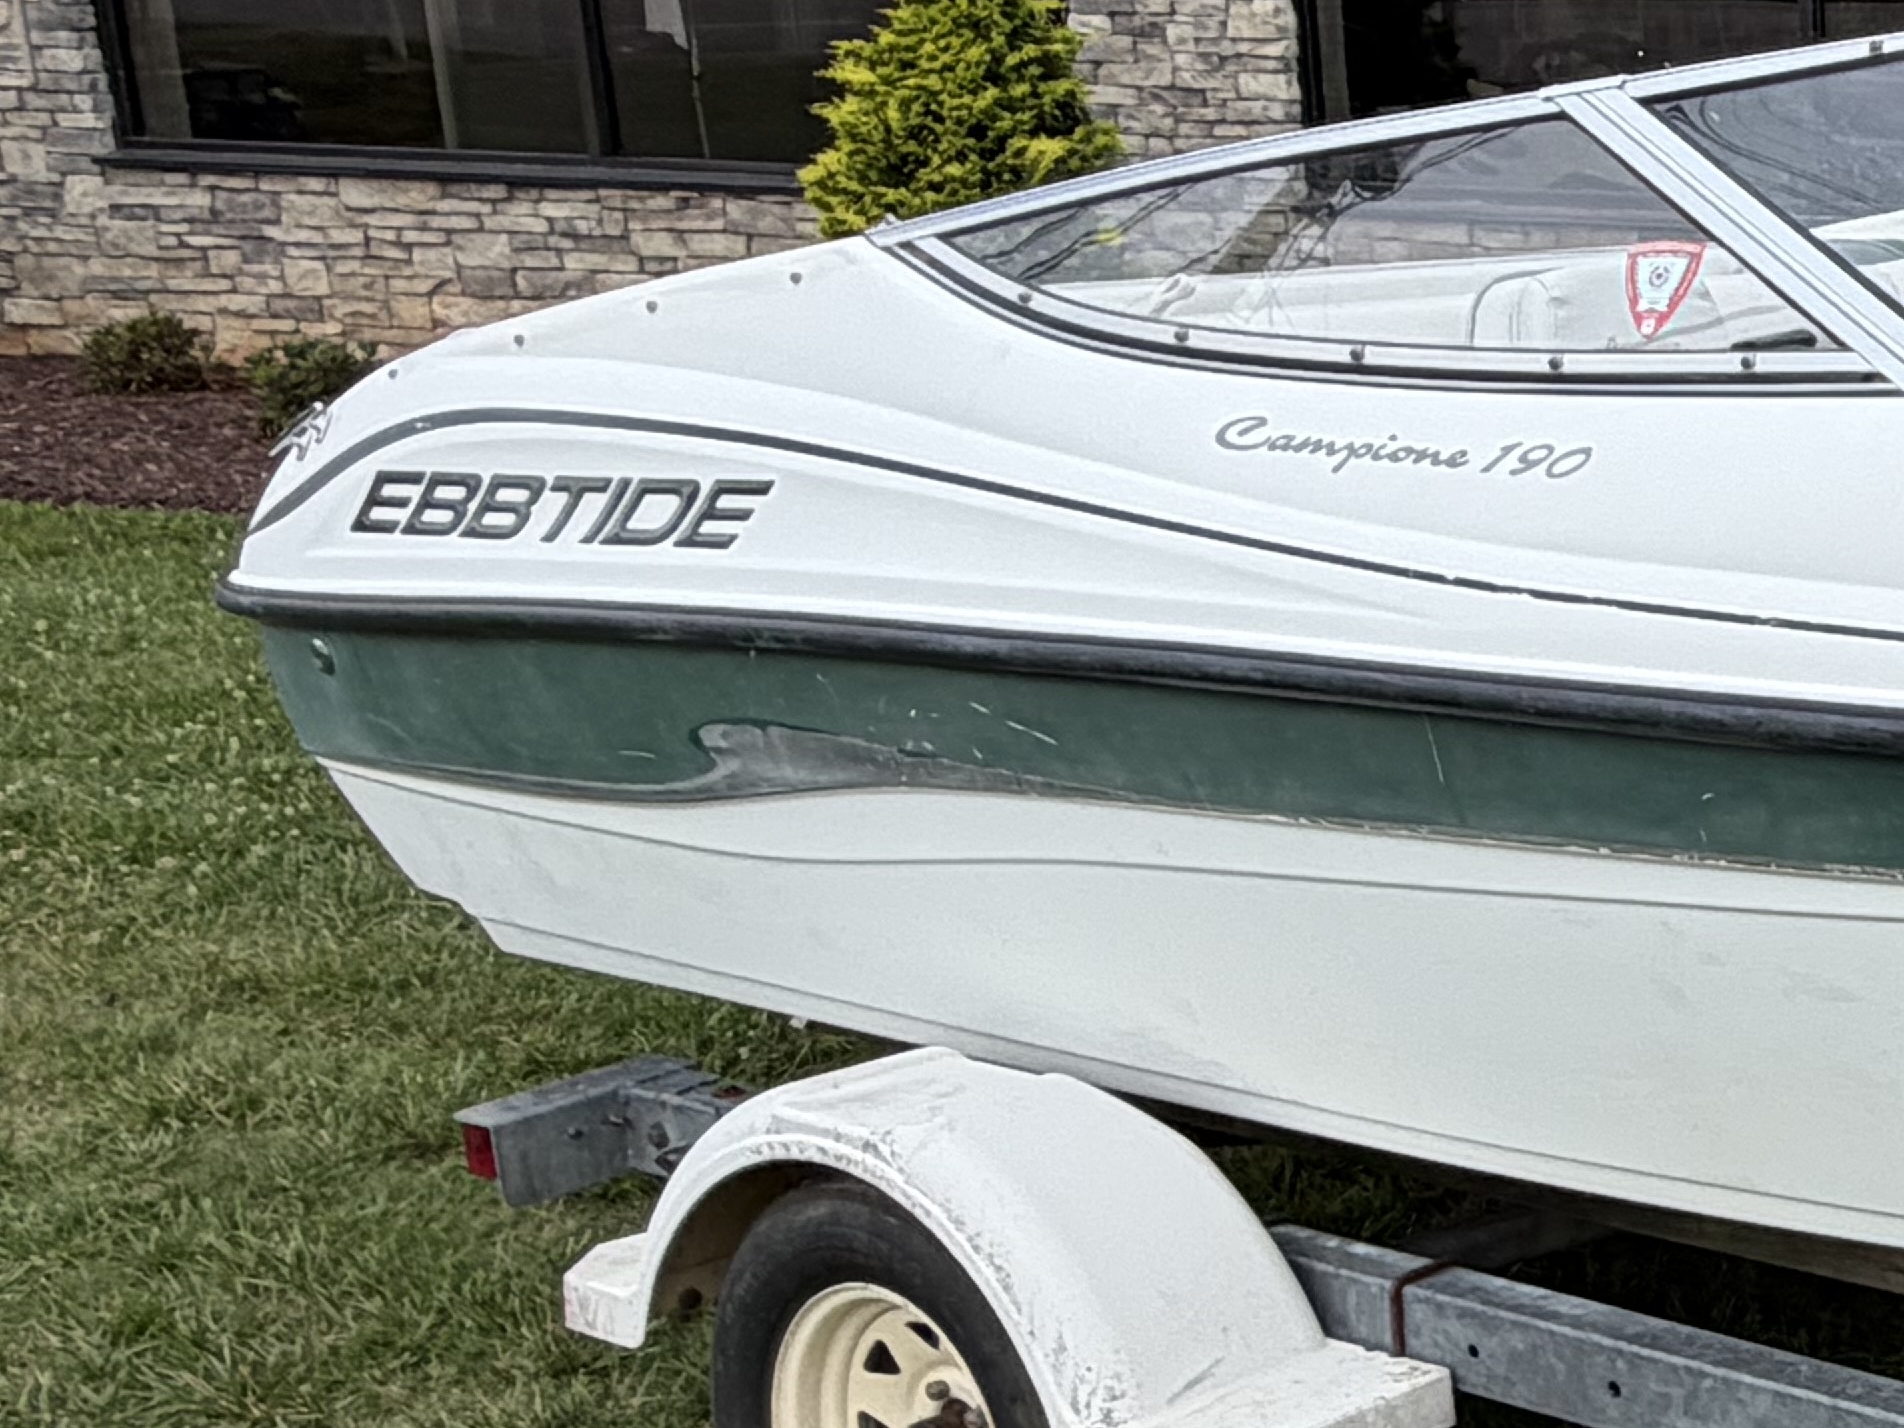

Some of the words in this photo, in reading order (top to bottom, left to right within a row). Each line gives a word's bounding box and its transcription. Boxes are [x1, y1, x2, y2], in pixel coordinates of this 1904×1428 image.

[1213, 415, 1470, 475] Campione
[1478, 439, 1594, 480] 190
[349, 468, 776, 551] EBBTIDE
